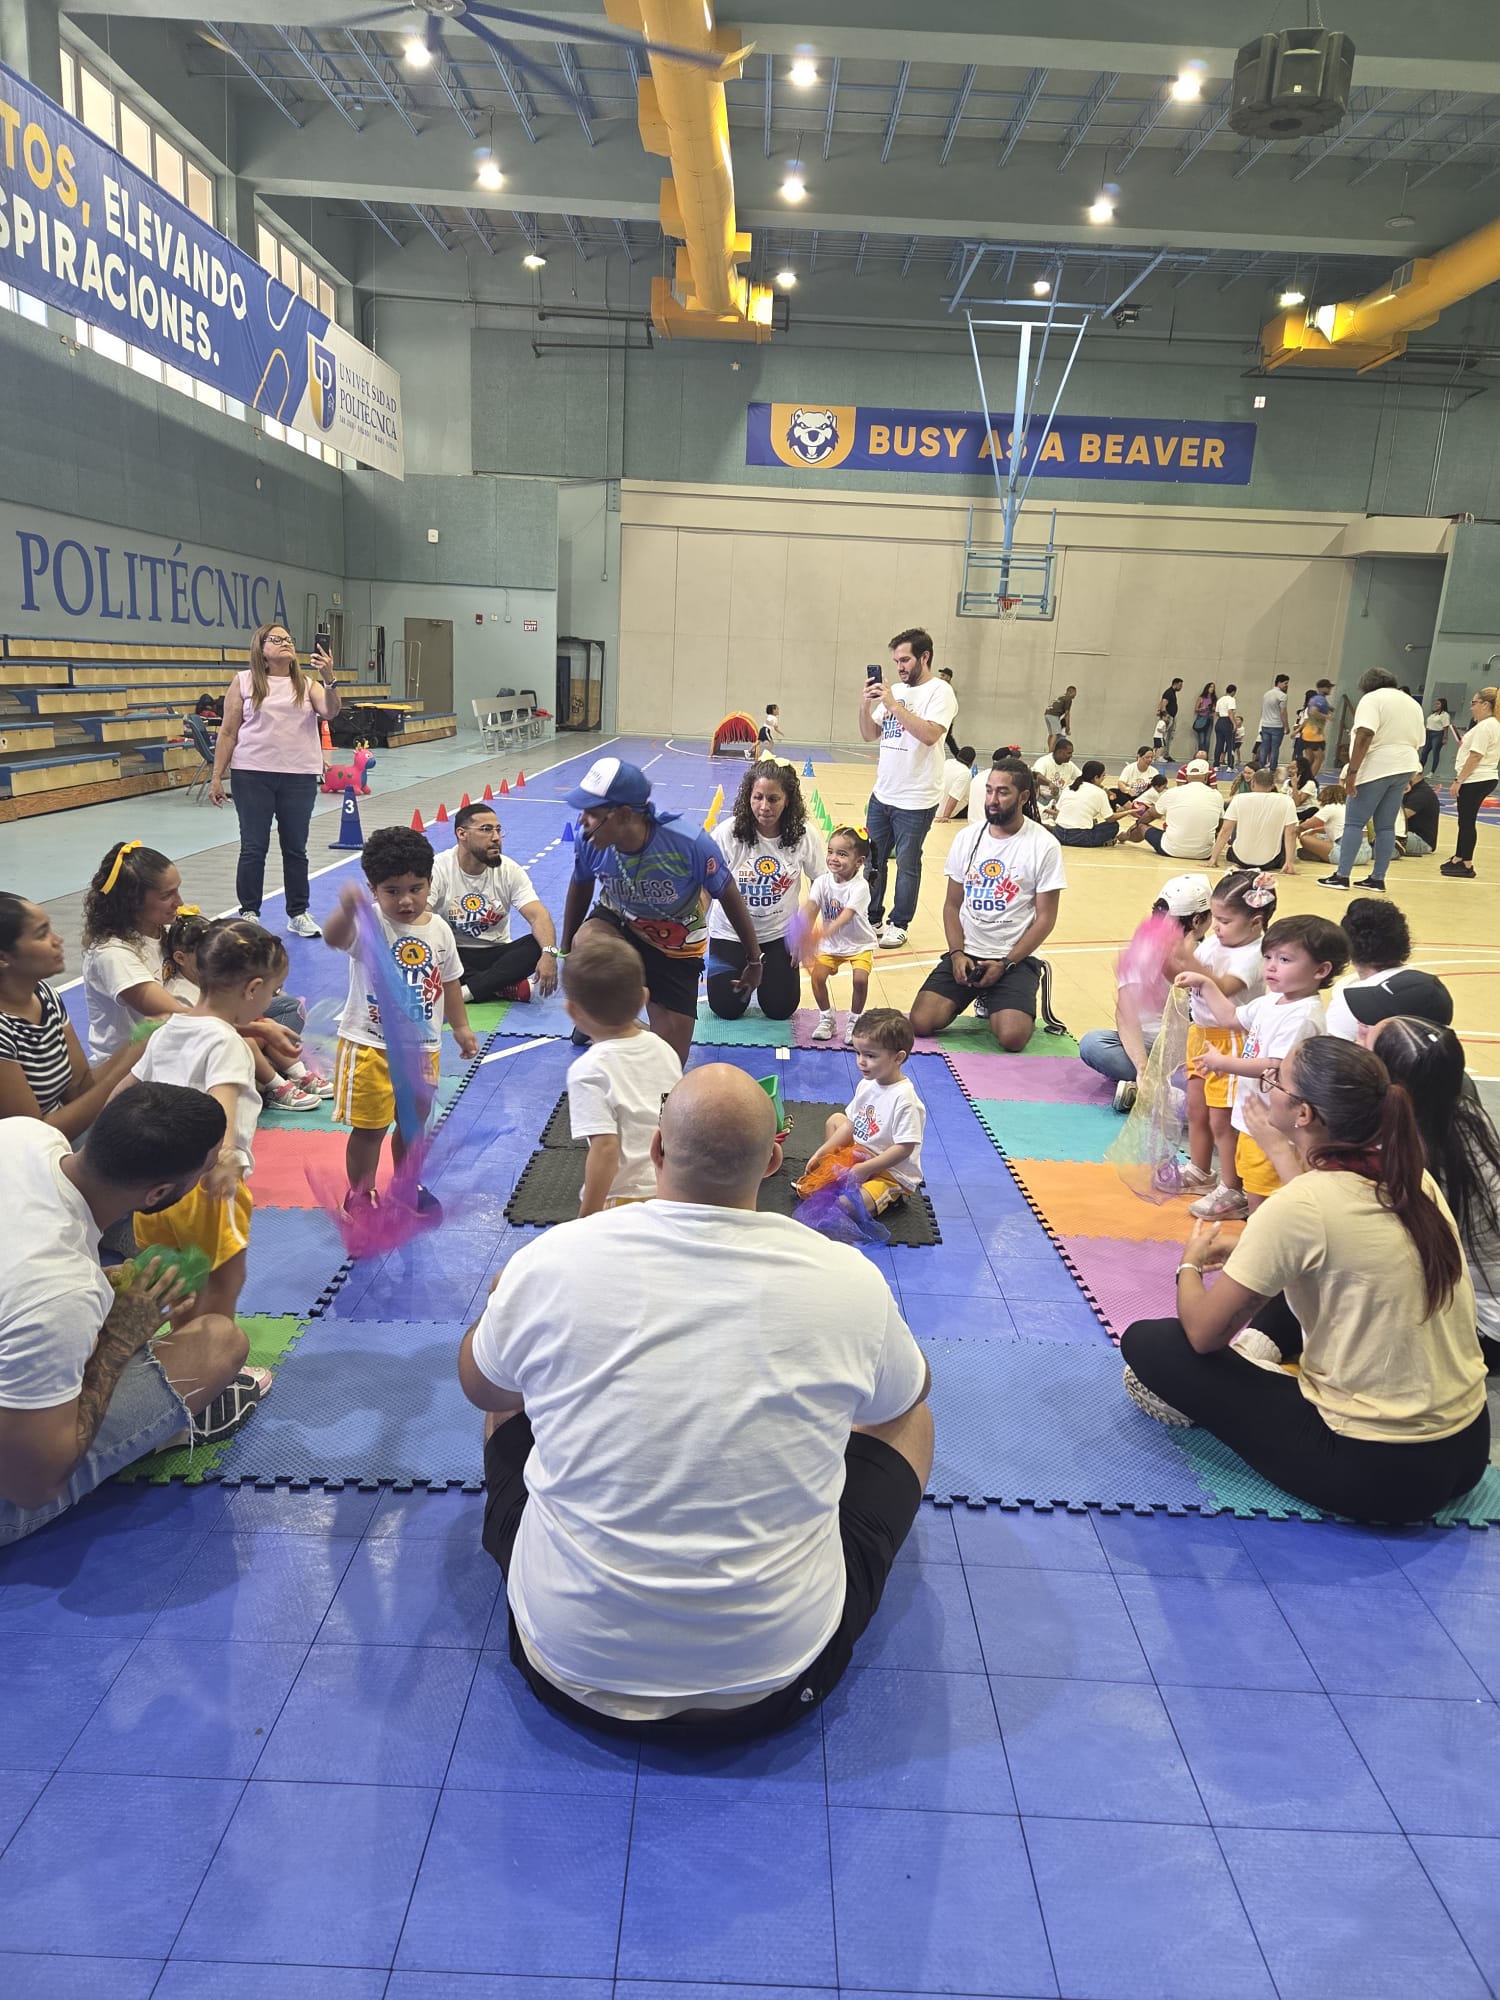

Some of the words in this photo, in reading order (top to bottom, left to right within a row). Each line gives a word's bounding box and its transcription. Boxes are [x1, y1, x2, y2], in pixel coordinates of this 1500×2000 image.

[103, 174, 247, 320] ELEVANDO
[869, 425, 967, 457] BUSY
[1039, 432, 1065, 462] A
[1079, 433, 1225, 468] BEAVER
[16, 530, 290, 630] POLITÉCNICA
[345, 799, 354, 814] 3
[739, 883, 771, 896] JUE
[965, 885, 995, 899] JUE
[749, 894, 782, 907] GOS
[972, 899, 1006, 911] GOS
